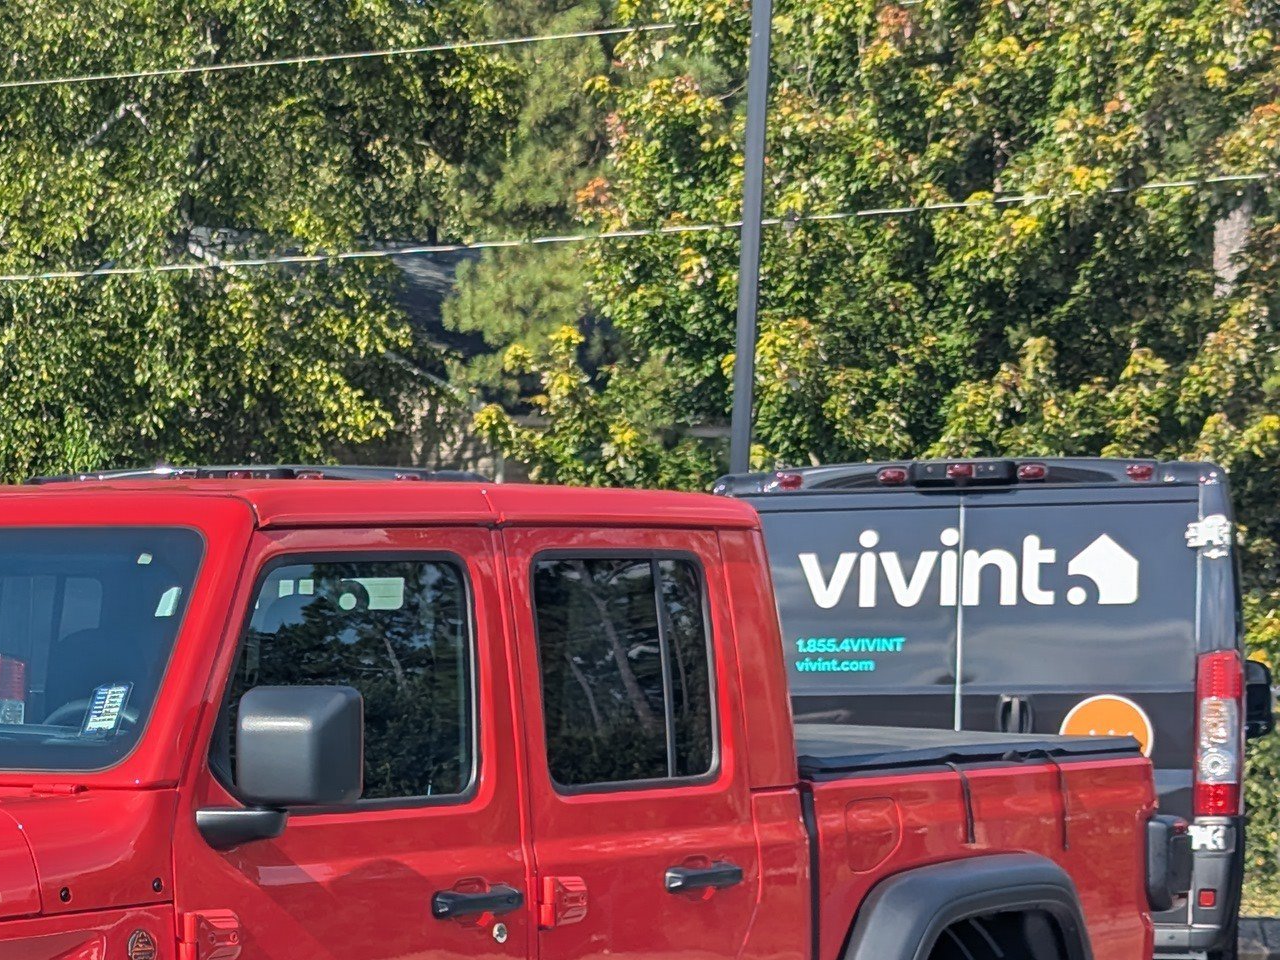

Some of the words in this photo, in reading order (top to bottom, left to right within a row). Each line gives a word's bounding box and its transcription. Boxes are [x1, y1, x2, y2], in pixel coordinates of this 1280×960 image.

[798, 527, 1057, 608] vivint
[796, 637, 906, 653] 1.855.4VIVINT
[795, 657, 875, 672] vivint.com
